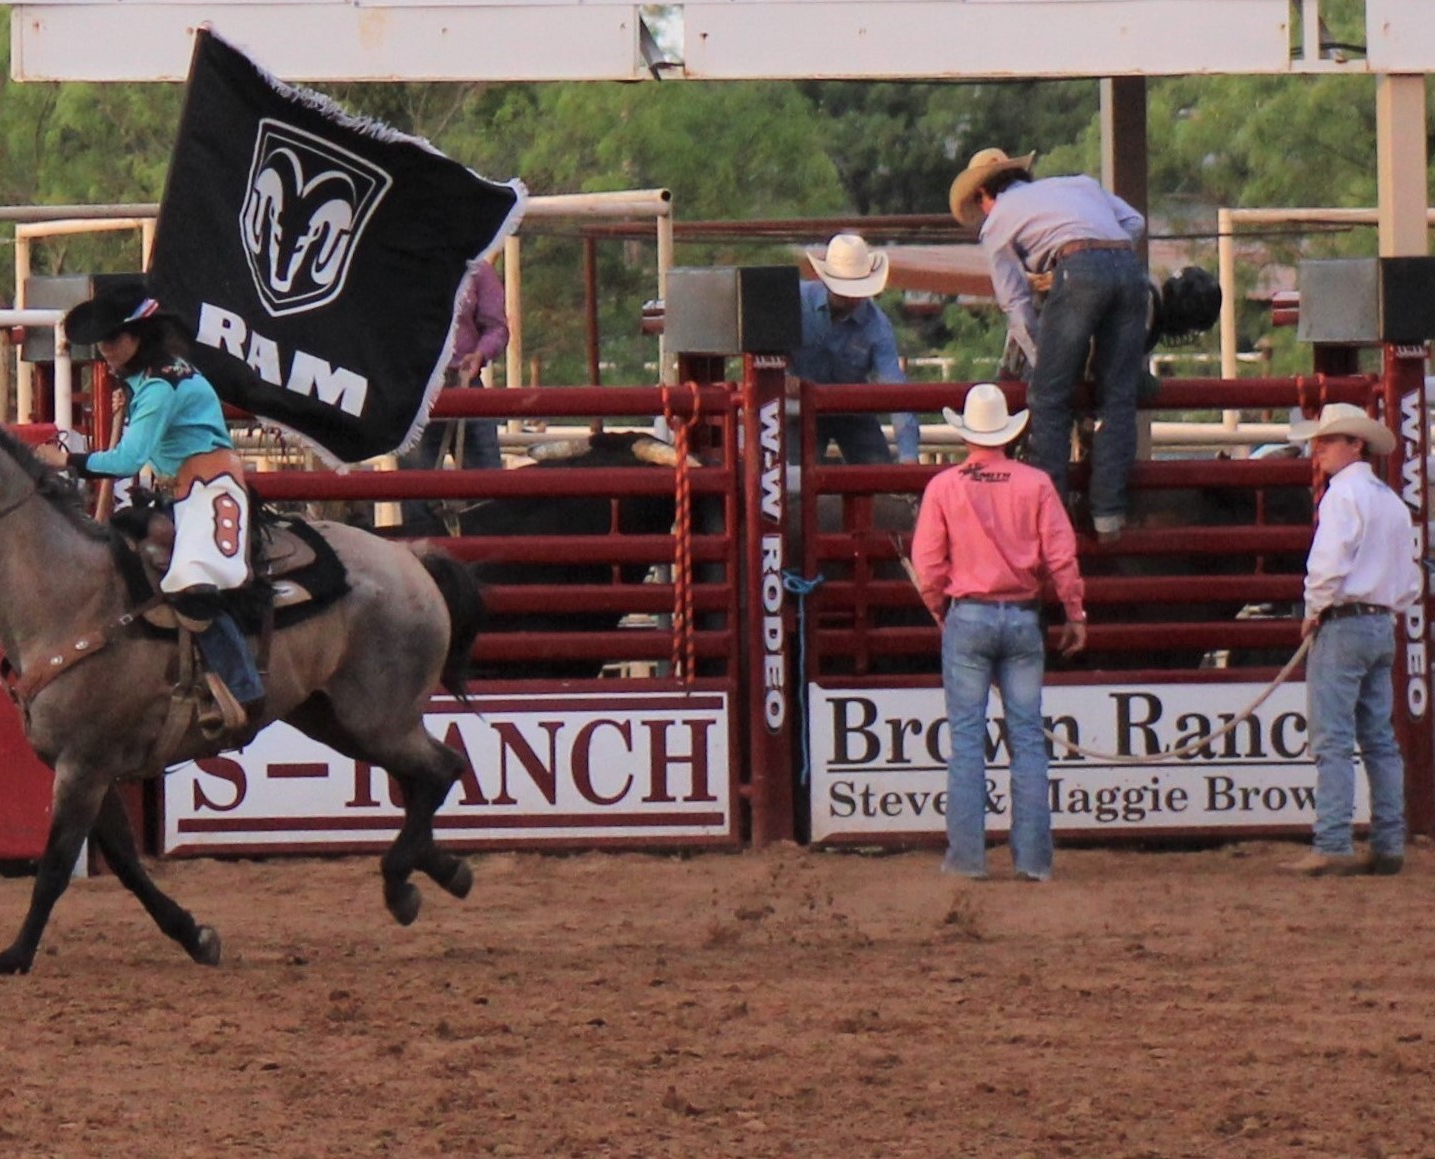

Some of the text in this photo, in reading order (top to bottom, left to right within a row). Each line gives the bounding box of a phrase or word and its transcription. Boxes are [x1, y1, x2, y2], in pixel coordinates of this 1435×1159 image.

[196, 301, 369, 418] RAM
[762, 533, 786, 733] RODEO
[1109, 692, 1310, 759] Ranc
[1203, 776, 1317, 813] Brow
